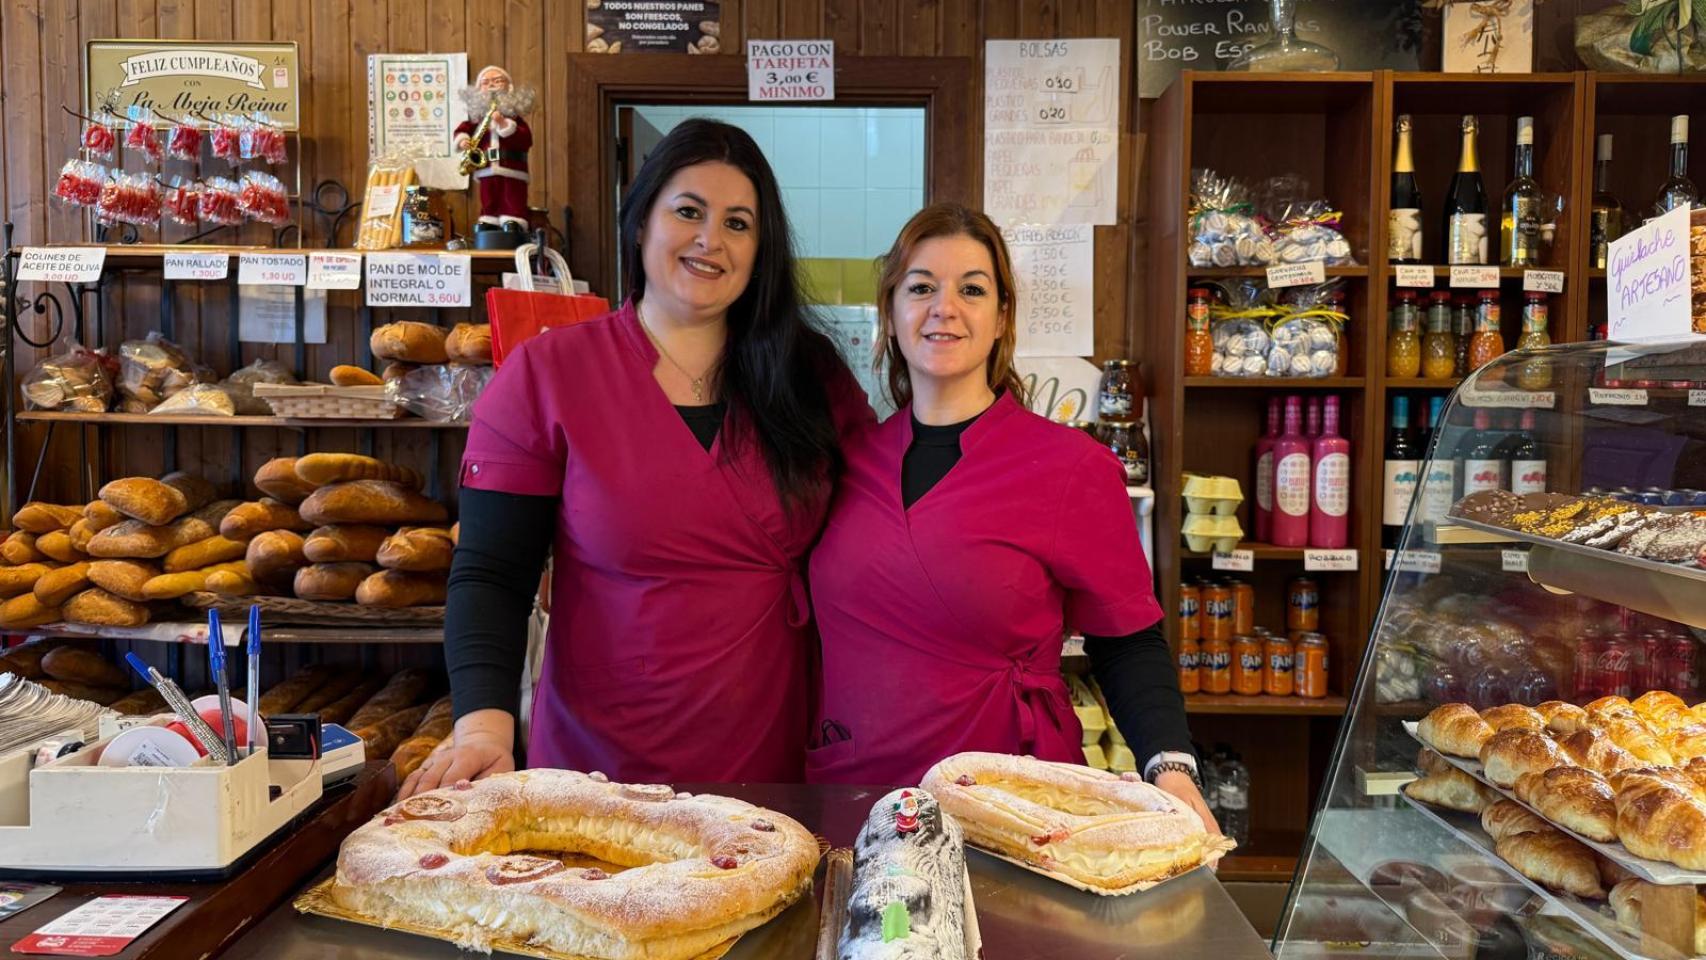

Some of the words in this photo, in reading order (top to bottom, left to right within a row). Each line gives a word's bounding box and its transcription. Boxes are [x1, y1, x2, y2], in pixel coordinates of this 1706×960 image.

[604, 2, 632, 10] TODOS
[677, 3, 704, 11] PANES
[644, 13, 683, 21] FRESCOS,
[619, 22, 632, 30] NO
[633, 22, 689, 31] CONGELADOS
[752, 45, 793, 56] PAGO
[797, 44, 830, 56] CON
[1019, 43, 1068, 58] BOLSAS
[1143, 41, 1199, 61] BOB
[131, 57, 168, 76] FELIZ
[170, 56, 256, 77] CUMPLEAÑOS
[752, 58, 830, 69] TARJETA
[766, 72, 801, 85] 3,00
[806, 72, 819, 83] €
[759, 86, 825, 98] MINIMO
[124, 91, 154, 110] La
[158, 91, 222, 116] Abeja
[225, 93, 289, 112] Reina
[25, 253, 66, 262] COLINES
[241, 256, 258, 265] PAN
[261, 257, 303, 266] TOSTADO
[22, 263, 57, 271] ACEITE
[59, 263, 72, 271] DE
[74, 263, 100, 271] OLIVA
[166, 259, 184, 267] PAN
[186, 259, 227, 268] RALLADO
[369, 264, 394, 275] PAN
[397, 264, 415, 275] DE
[418, 265, 461, 276] MOLDE
[370, 279, 433, 289] INTEGRAL
[436, 280, 445, 289] O
[1621, 254, 1686, 311] ARTESANO
[370, 293, 424, 304] NORMAL
